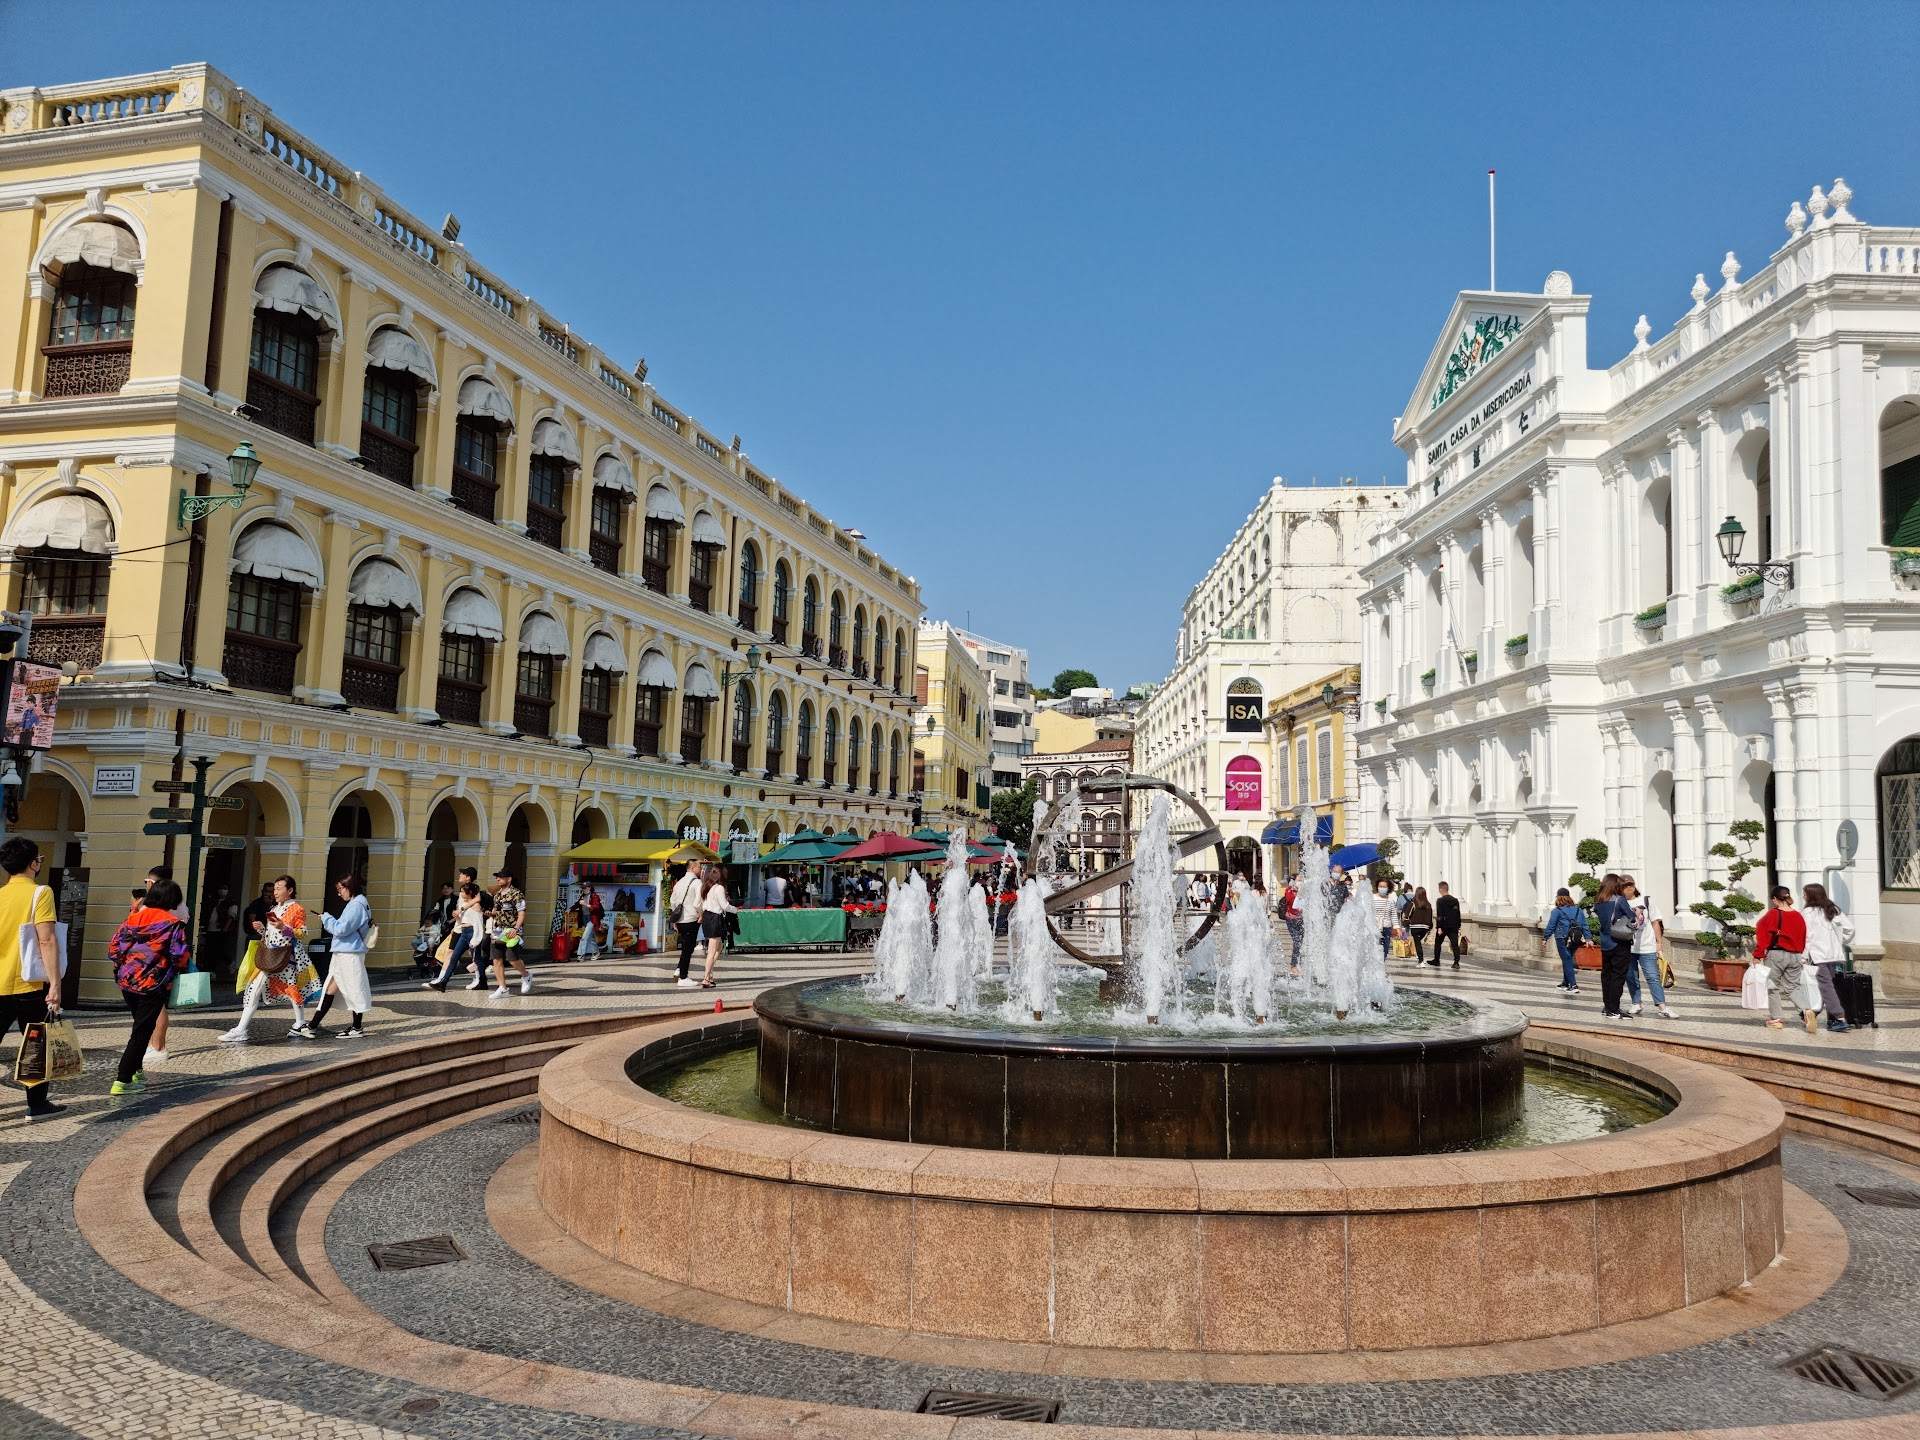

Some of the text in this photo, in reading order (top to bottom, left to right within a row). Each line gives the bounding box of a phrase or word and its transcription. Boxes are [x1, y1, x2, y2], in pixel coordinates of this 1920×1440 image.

[1428, 372, 1532, 465] SANTA CASA DA MISERICORDIA
[1229, 704, 1260, 720] ISA
